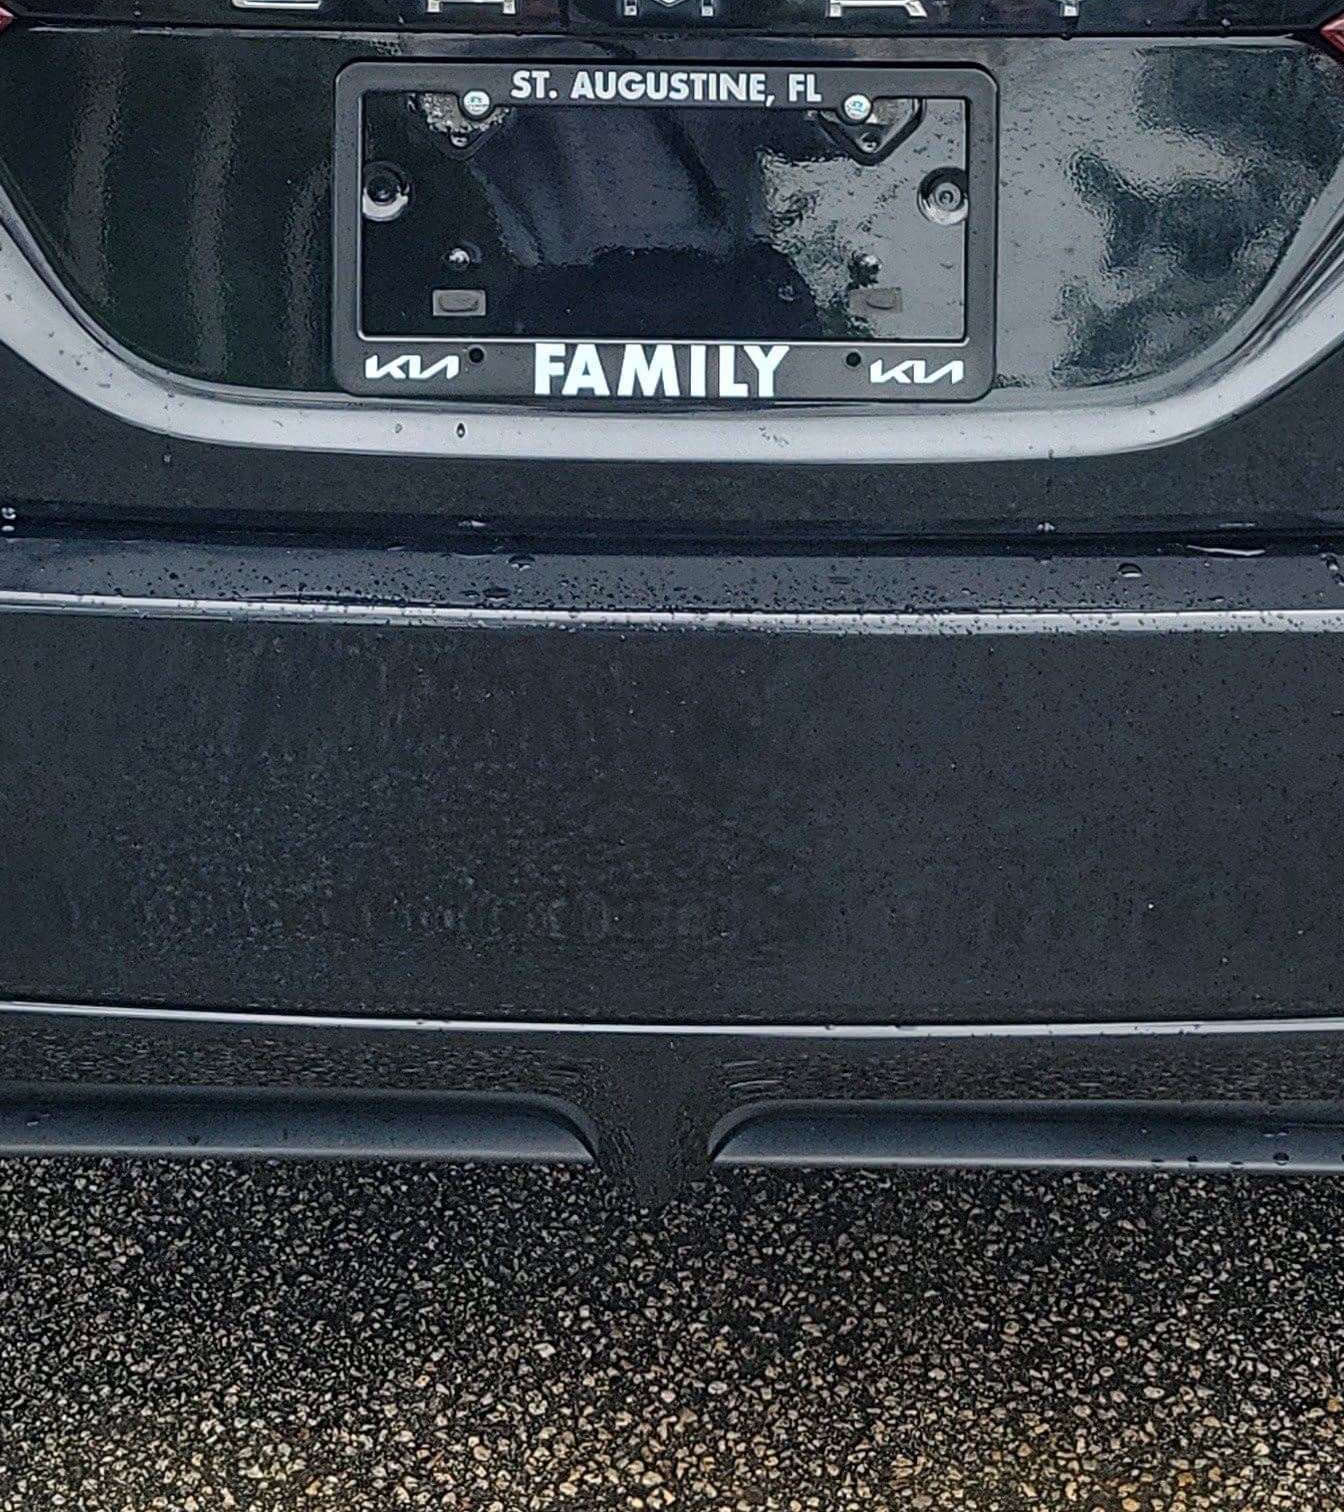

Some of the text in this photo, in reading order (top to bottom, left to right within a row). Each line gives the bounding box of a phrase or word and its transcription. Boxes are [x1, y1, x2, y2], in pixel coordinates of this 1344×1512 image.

[510, 70, 822, 107] ST. AUGUSTINE, FL
[534, 342, 791, 398] FAMILY
